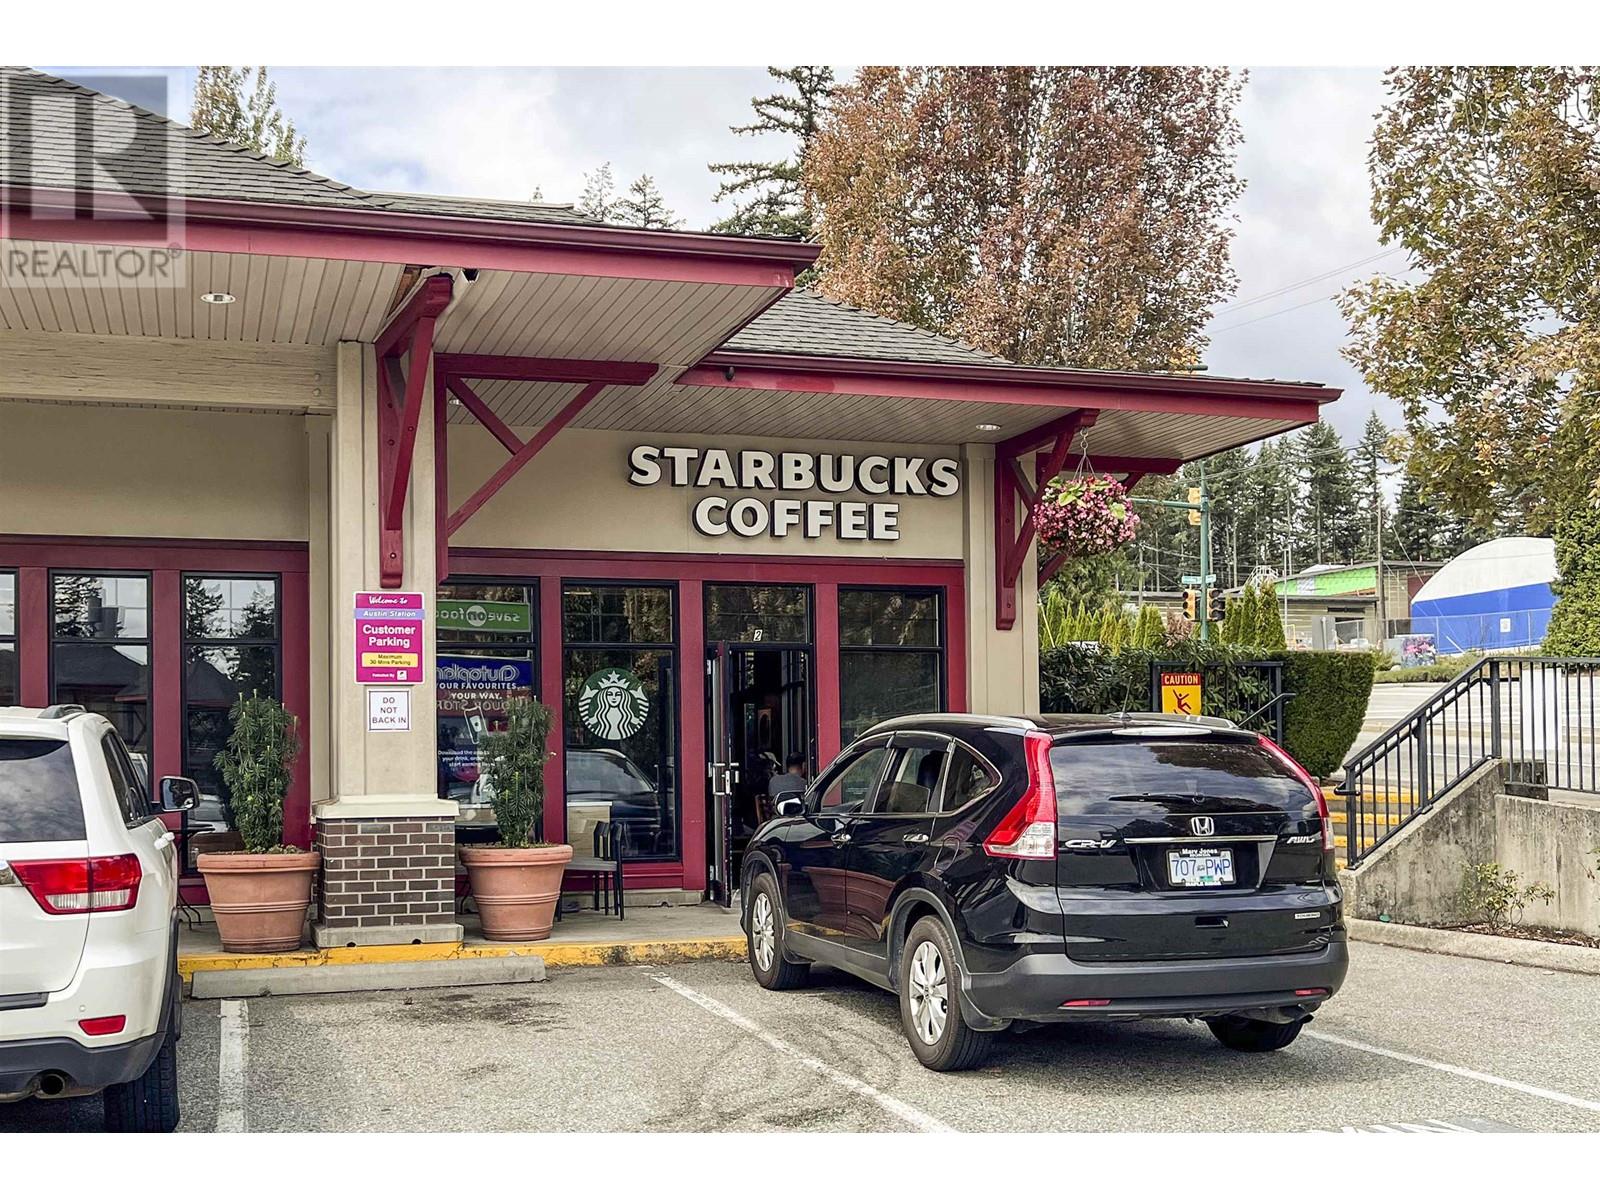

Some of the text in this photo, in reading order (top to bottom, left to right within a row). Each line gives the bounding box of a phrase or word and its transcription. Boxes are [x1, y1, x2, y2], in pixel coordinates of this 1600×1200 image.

[628, 445, 961, 497] STARBUCKS
[693, 496, 901, 541] COFFEE
[369, 596, 398, 605] Welcome
[363, 624, 416, 635] Customer
[754, 630, 763, 641] 2
[369, 636, 410, 649] Parking
[1164, 674, 1199, 686] CAUTION
[382, 696, 396, 705] DO
[451, 692, 503, 700] YOUR WAY.
[380, 706, 398, 714] NOT
[372, 716, 407, 724] BACK IN
[1065, 839, 1117, 849] CR-V
[1182, 847, 1218, 856] Mary Jones
[1171, 858, 1231, 876] 707 PWP
